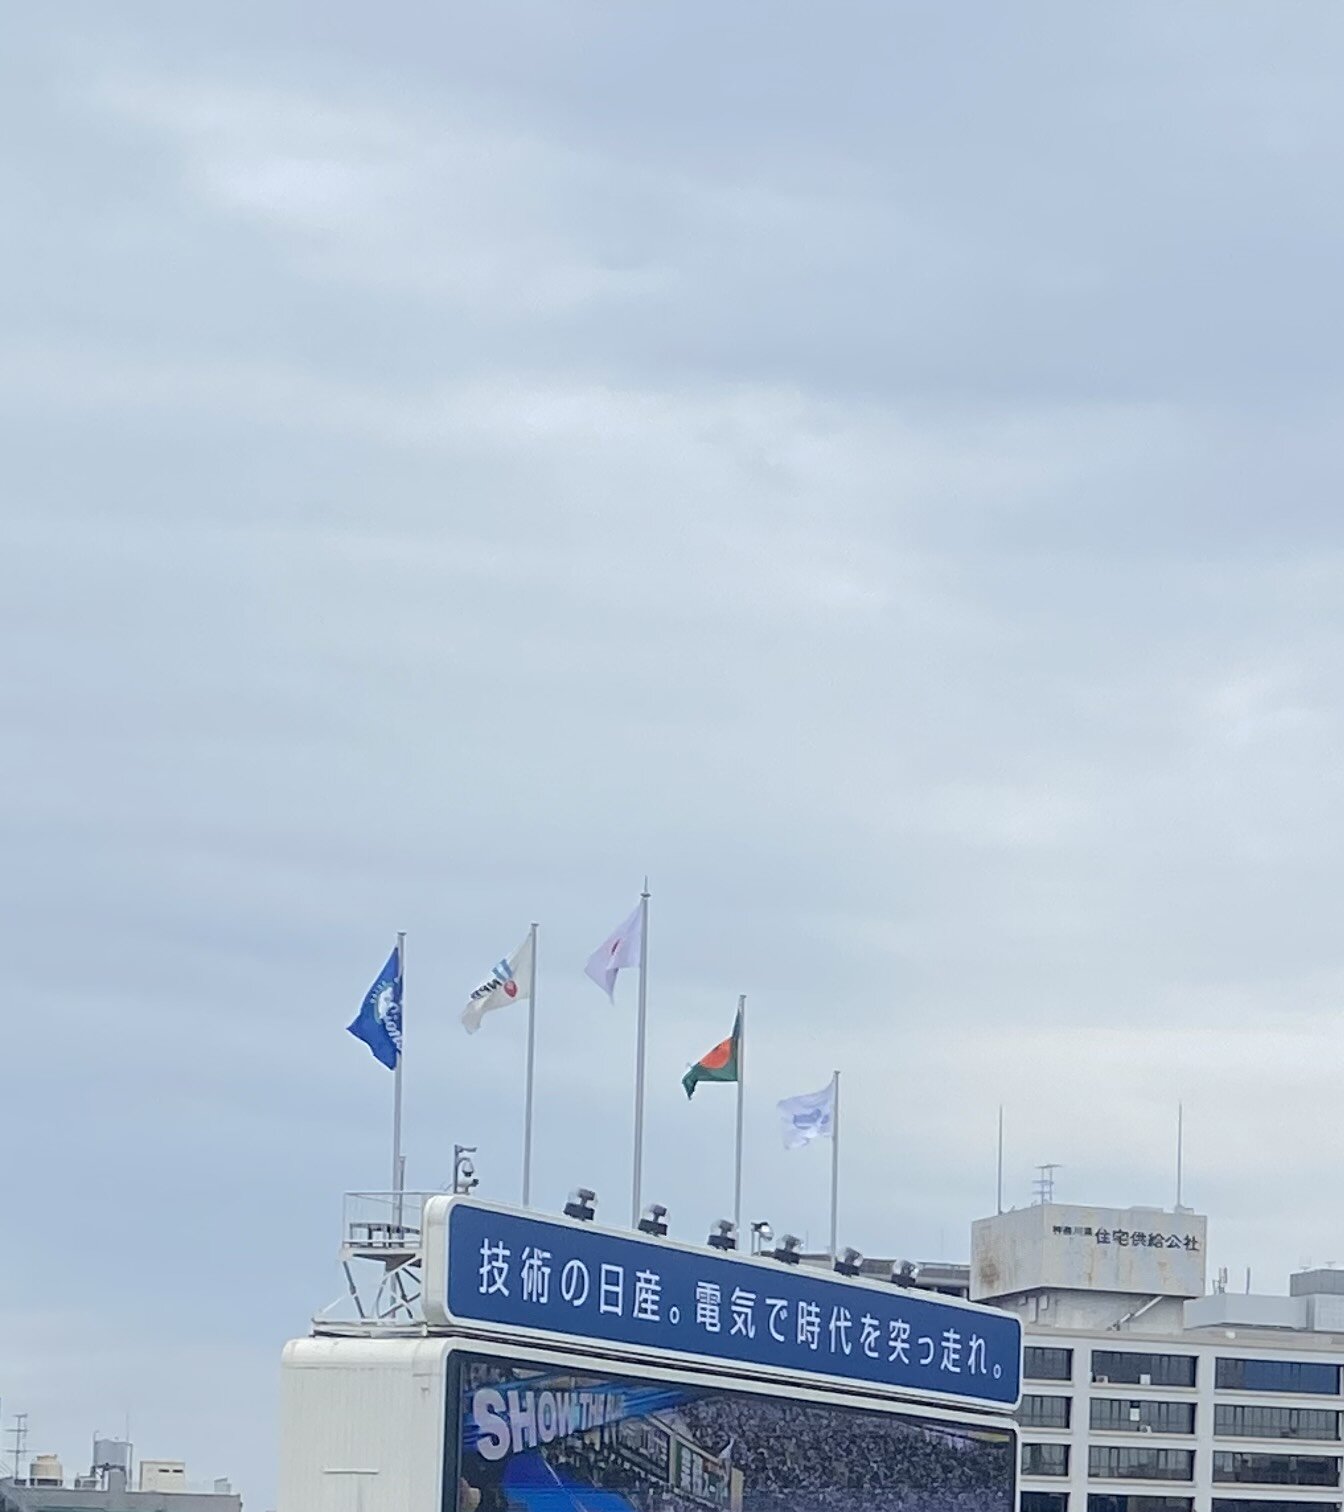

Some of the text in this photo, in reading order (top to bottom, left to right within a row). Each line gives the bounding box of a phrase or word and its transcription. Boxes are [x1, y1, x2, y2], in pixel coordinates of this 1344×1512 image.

[1095, 1226, 1201, 1252] 住宅供給公社
[478, 1236, 1003, 1381] 技術の日産。電気で時代を突っ走れ。
[473, 1388, 575, 1461] SHOW
